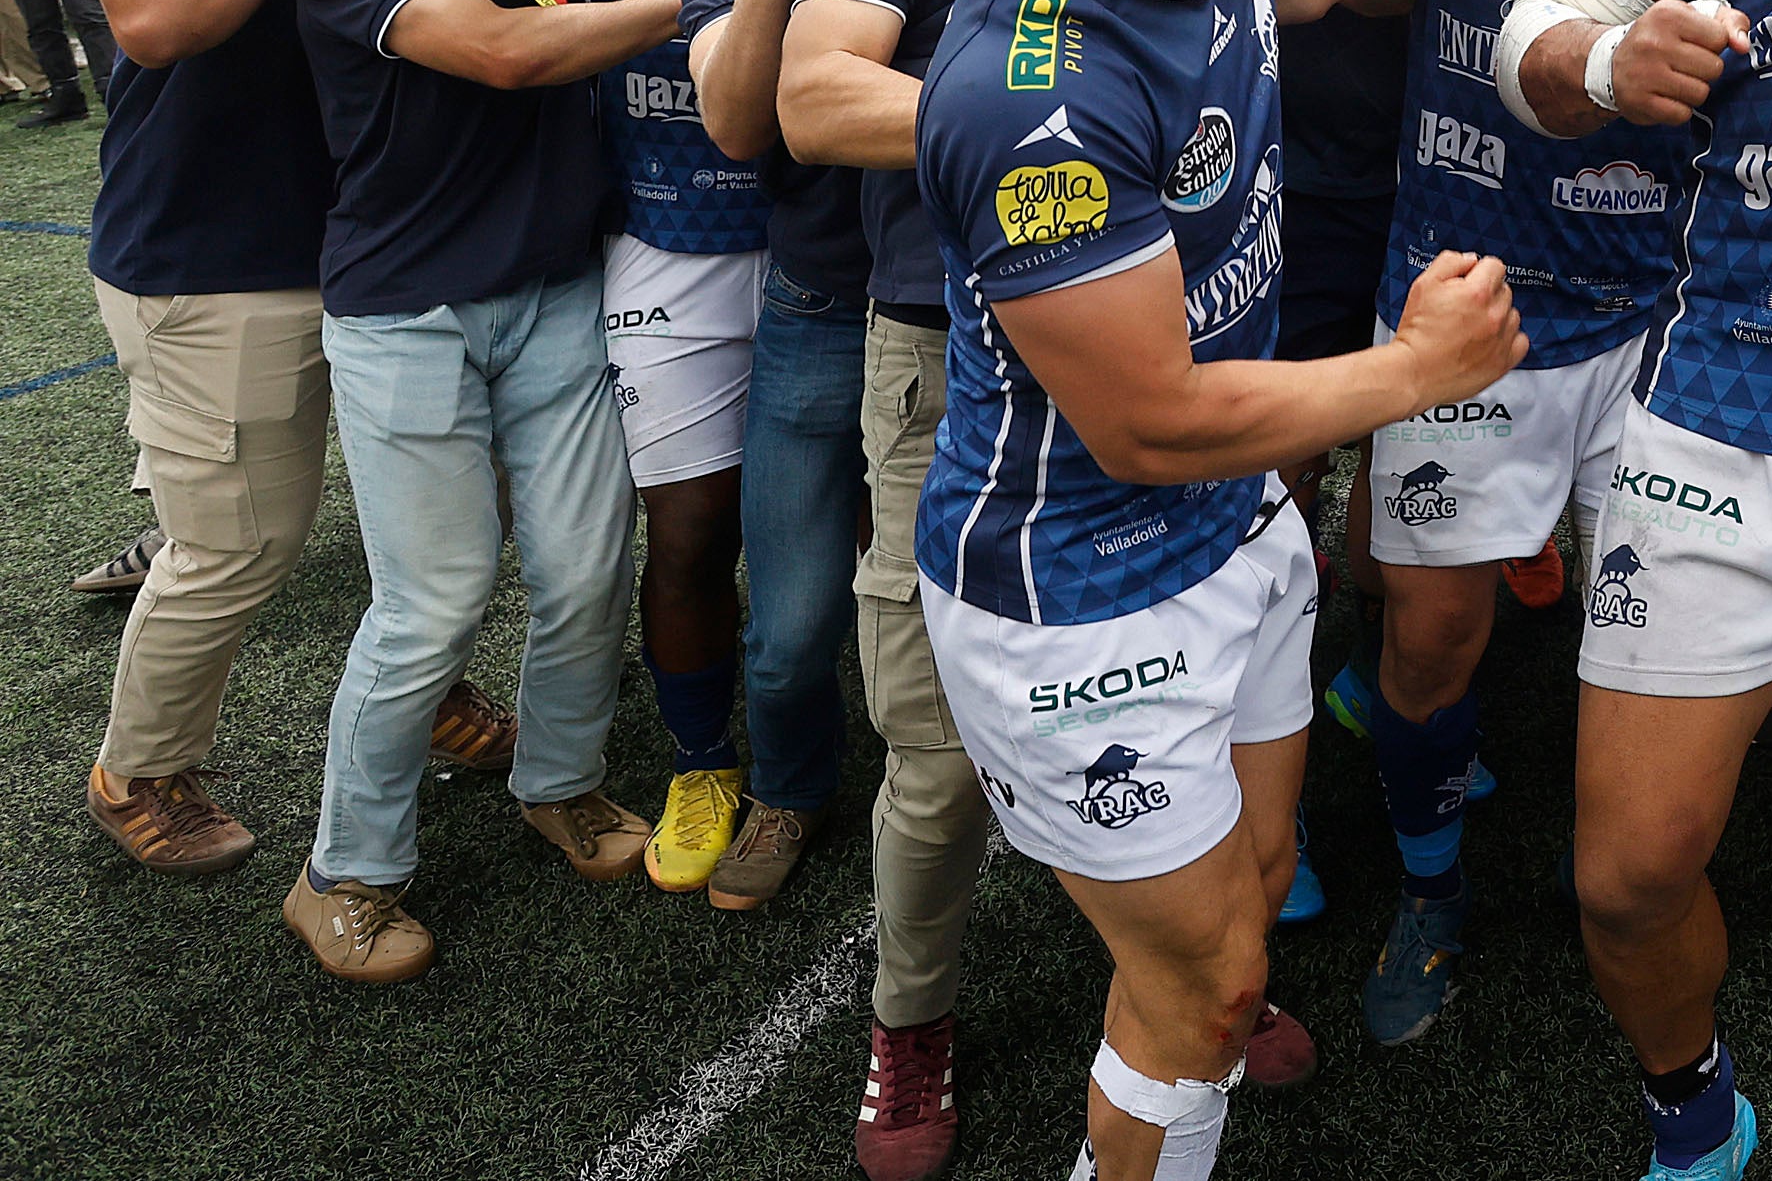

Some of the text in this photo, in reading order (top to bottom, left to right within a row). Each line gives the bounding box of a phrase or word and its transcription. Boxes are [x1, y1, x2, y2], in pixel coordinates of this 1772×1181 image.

[1063, 15, 1085, 74] PIVOT
[1208, 14, 1238, 67] MERCURY
[626, 71, 704, 119] gaz
[1175, 121, 1228, 180] Estrella
[1416, 108, 1506, 177] gaza
[631, 186, 678, 202] Valladolid
[997, 166, 1107, 205] tierra
[1175, 148, 1233, 200] Galicia
[1008, 200, 1040, 225] de
[1555, 180, 1664, 211] LEVANOVA
[998, 243, 1070, 277] CASTILLA
[1071, 234, 1086, 251] Y
[1386, 423, 1513, 444] SEGAUTO
[1092, 515, 1152, 542] Ayuntamiento
[1384, 496, 1458, 521] VRAC
[1094, 519, 1169, 557] Valladolid
[1066, 780, 1171, 829] VRAC
